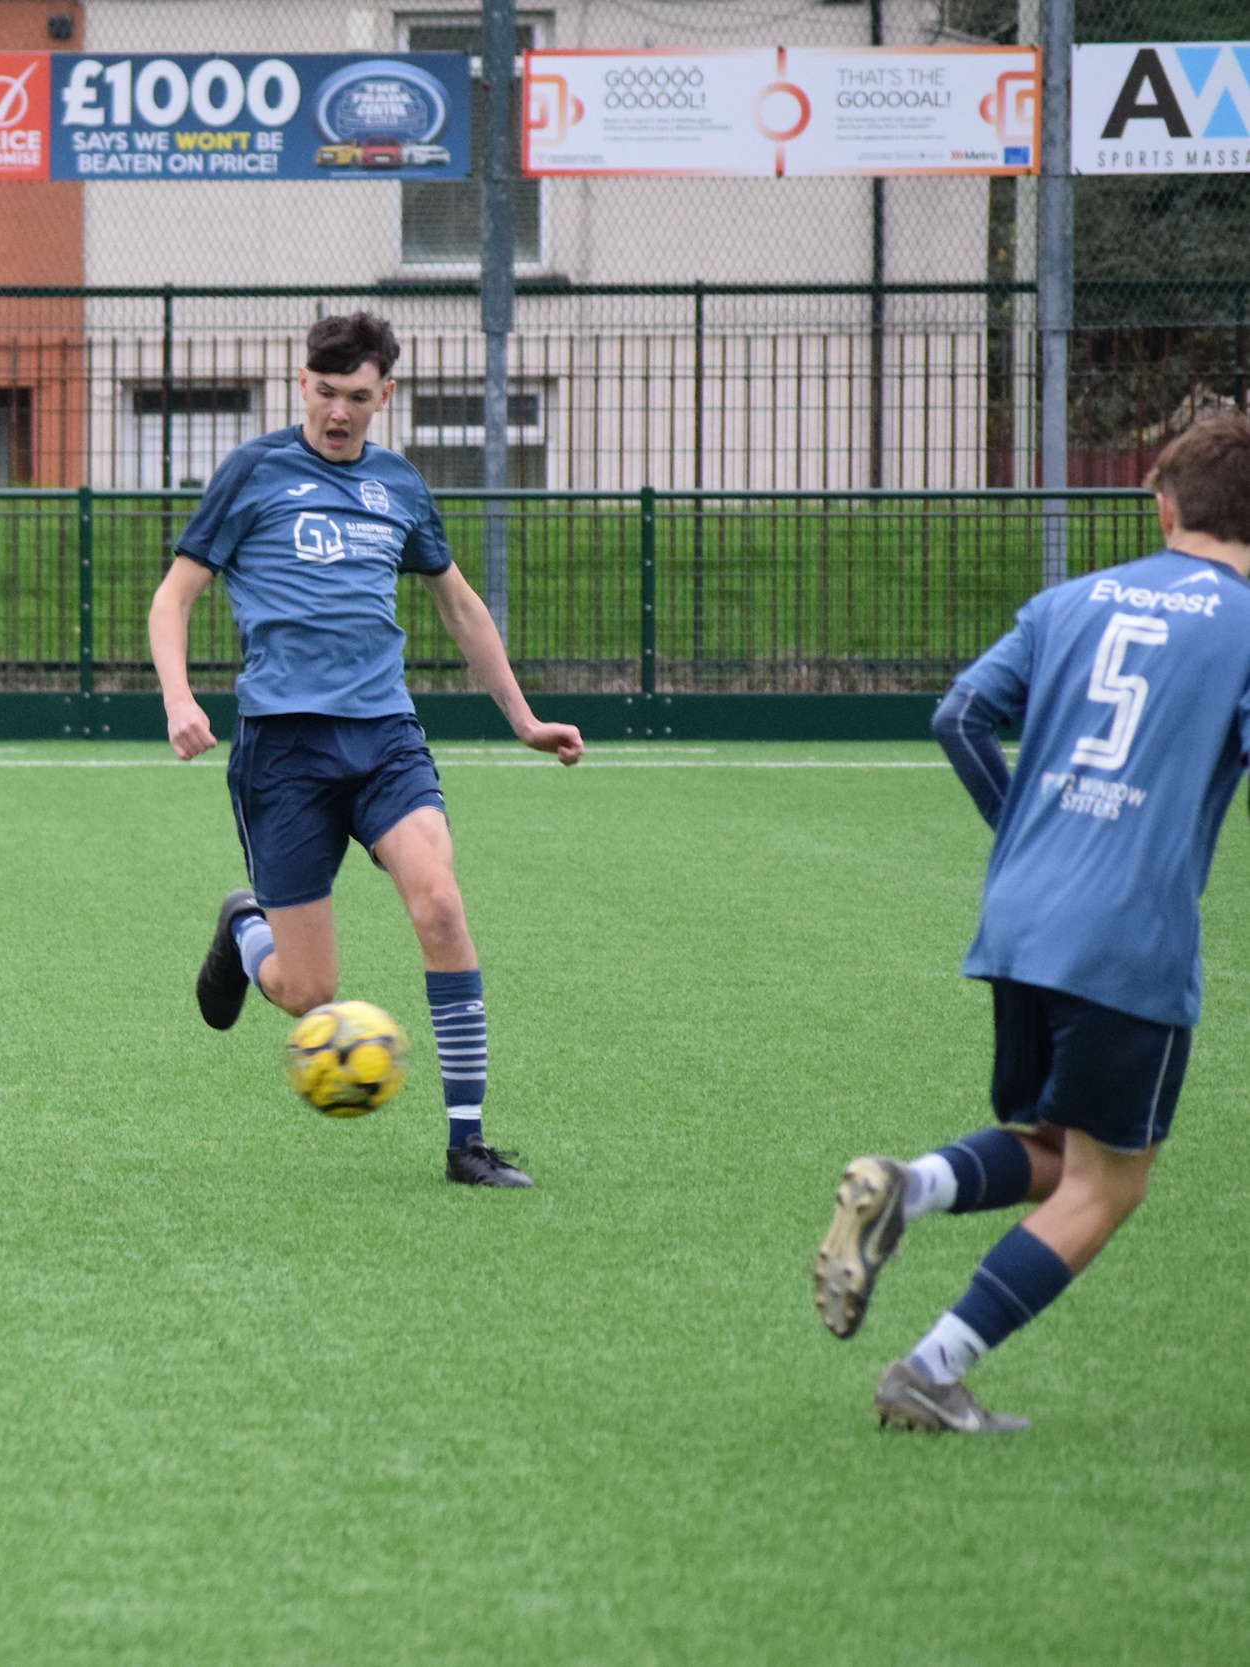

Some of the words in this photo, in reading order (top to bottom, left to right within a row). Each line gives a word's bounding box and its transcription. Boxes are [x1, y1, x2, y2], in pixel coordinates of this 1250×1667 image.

[837, 68, 903, 86] THAT'S
[907, 68, 946, 86] THE
[61, 58, 301, 127] £1000
[72, 131, 129, 152] SAYS
[134, 131, 170, 151] WE
[175, 130, 251, 151] WON'T
[255, 131, 284, 152] BE
[78, 154, 163, 174] BEATEN
[167, 154, 202, 174] ON
[206, 153, 279, 174] PRICE!
[963, 150, 998, 161] Metro
[1097, 150, 1175, 168] SPORTS
[1089, 578, 1222, 617] Everest
[1070, 611, 1170, 771] 5
